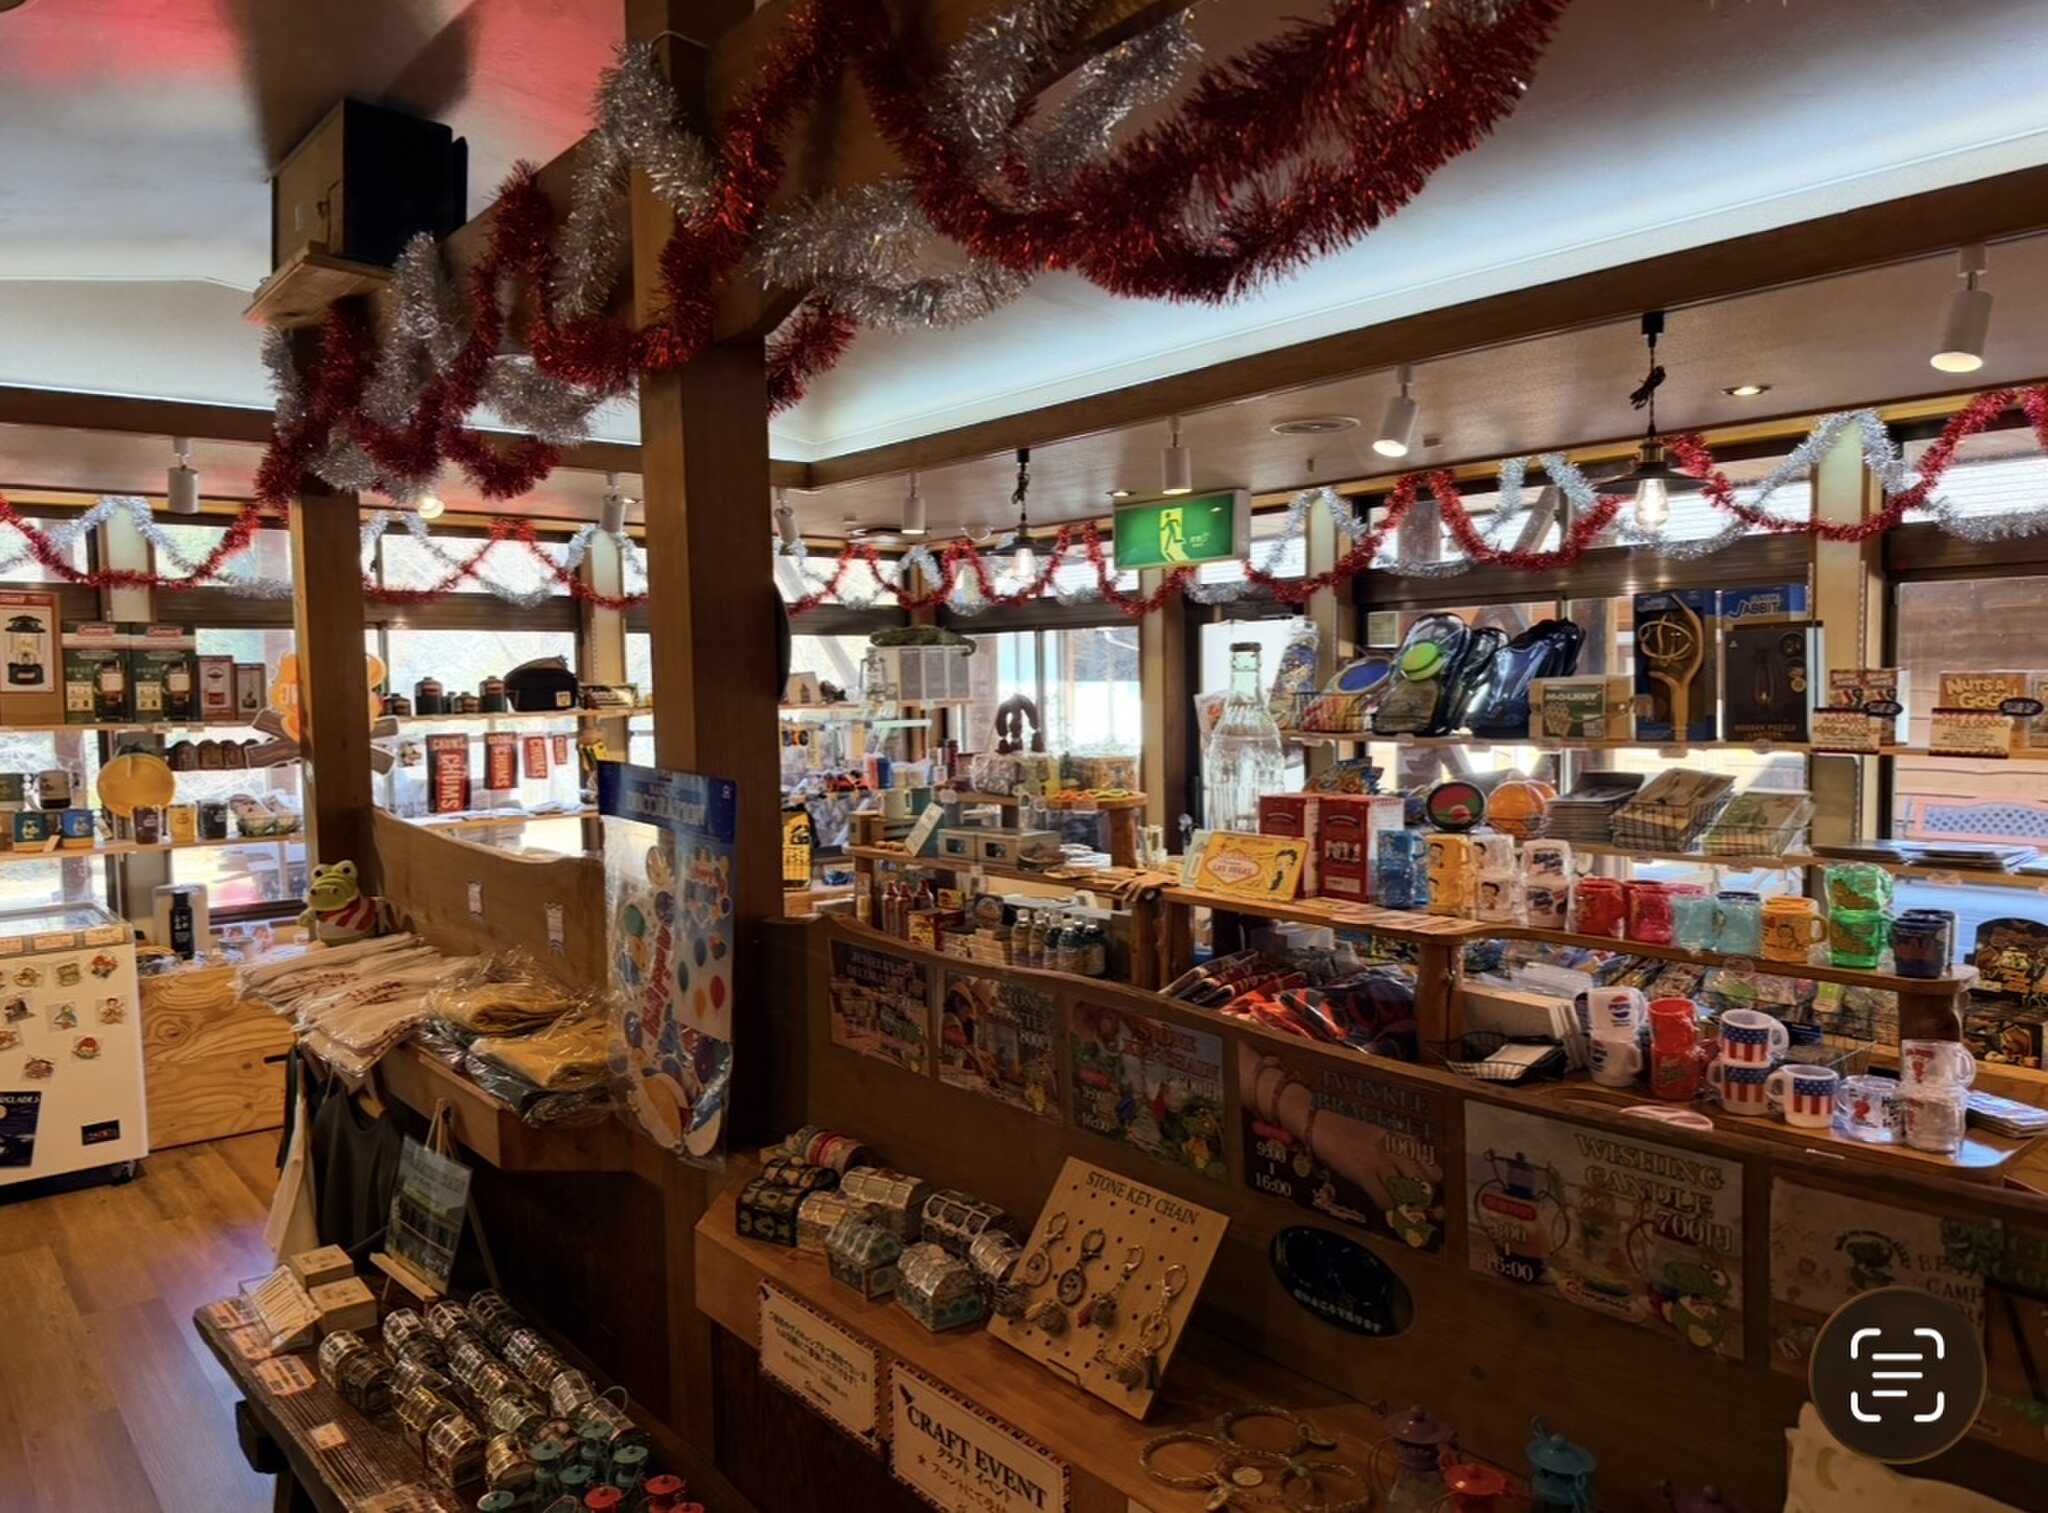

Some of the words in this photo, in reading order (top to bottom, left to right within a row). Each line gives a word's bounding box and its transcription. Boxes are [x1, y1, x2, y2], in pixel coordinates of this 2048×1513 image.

[440, 752, 461, 809] CHUMS
[1573, 1132, 1726, 1191] WISHING
[1086, 1171, 1128, 1198] STONE
[1126, 1187, 1157, 1208] KEY
[1154, 1197, 1200, 1225] CHAIN
[1584, 1164, 1713, 1217] CANDLE
[907, 1404, 971, 1460] CRAFT
[975, 1446, 1049, 1511] EVENT
